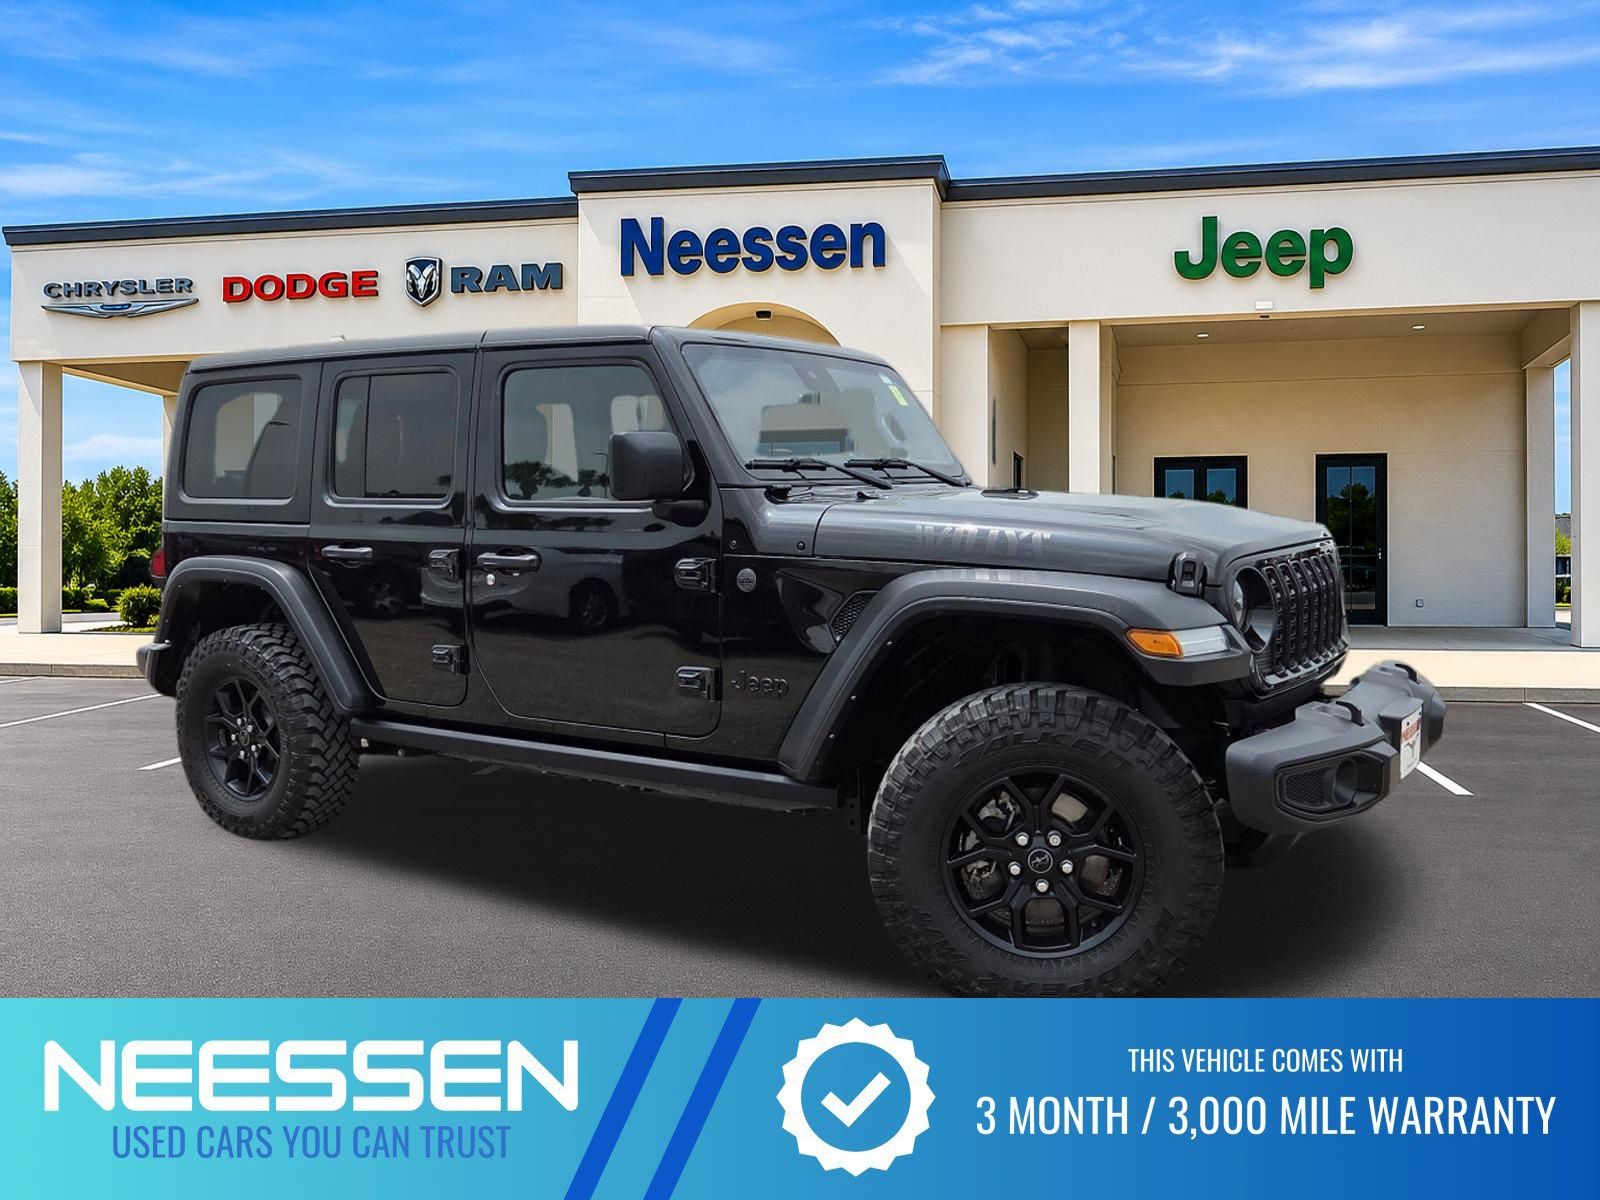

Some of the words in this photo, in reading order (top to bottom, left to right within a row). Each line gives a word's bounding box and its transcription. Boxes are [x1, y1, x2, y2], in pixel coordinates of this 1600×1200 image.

[620, 216, 886, 277] Neessen
[1174, 215, 1354, 290] Jeep
[43, 277, 194, 299] CHRYSLER
[222, 270, 379, 303] DODGE
[450, 262, 564, 294] RAM
[730, 669, 791, 701] Jeep
